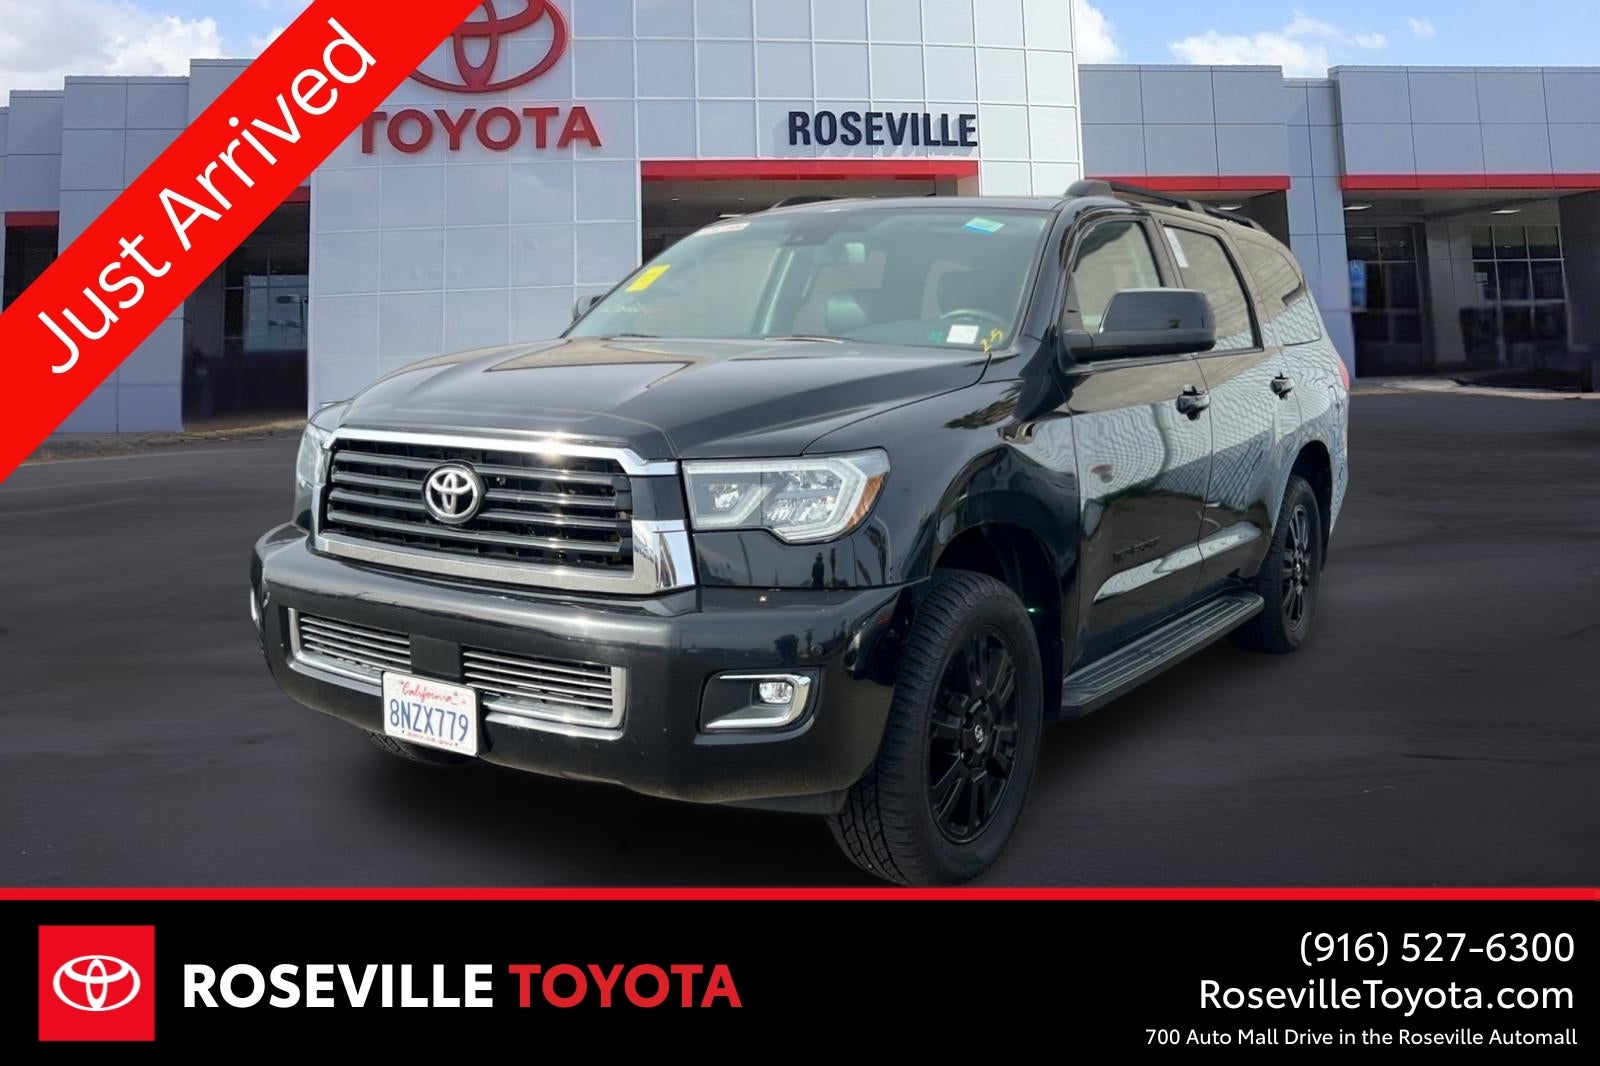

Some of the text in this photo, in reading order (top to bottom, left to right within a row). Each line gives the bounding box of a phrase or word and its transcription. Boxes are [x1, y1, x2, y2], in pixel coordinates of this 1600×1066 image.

[361, 106, 602, 154] TOYOTA
[788, 111, 978, 147] ROSEVILLE
[389, 698, 469, 742] 8NZX779
